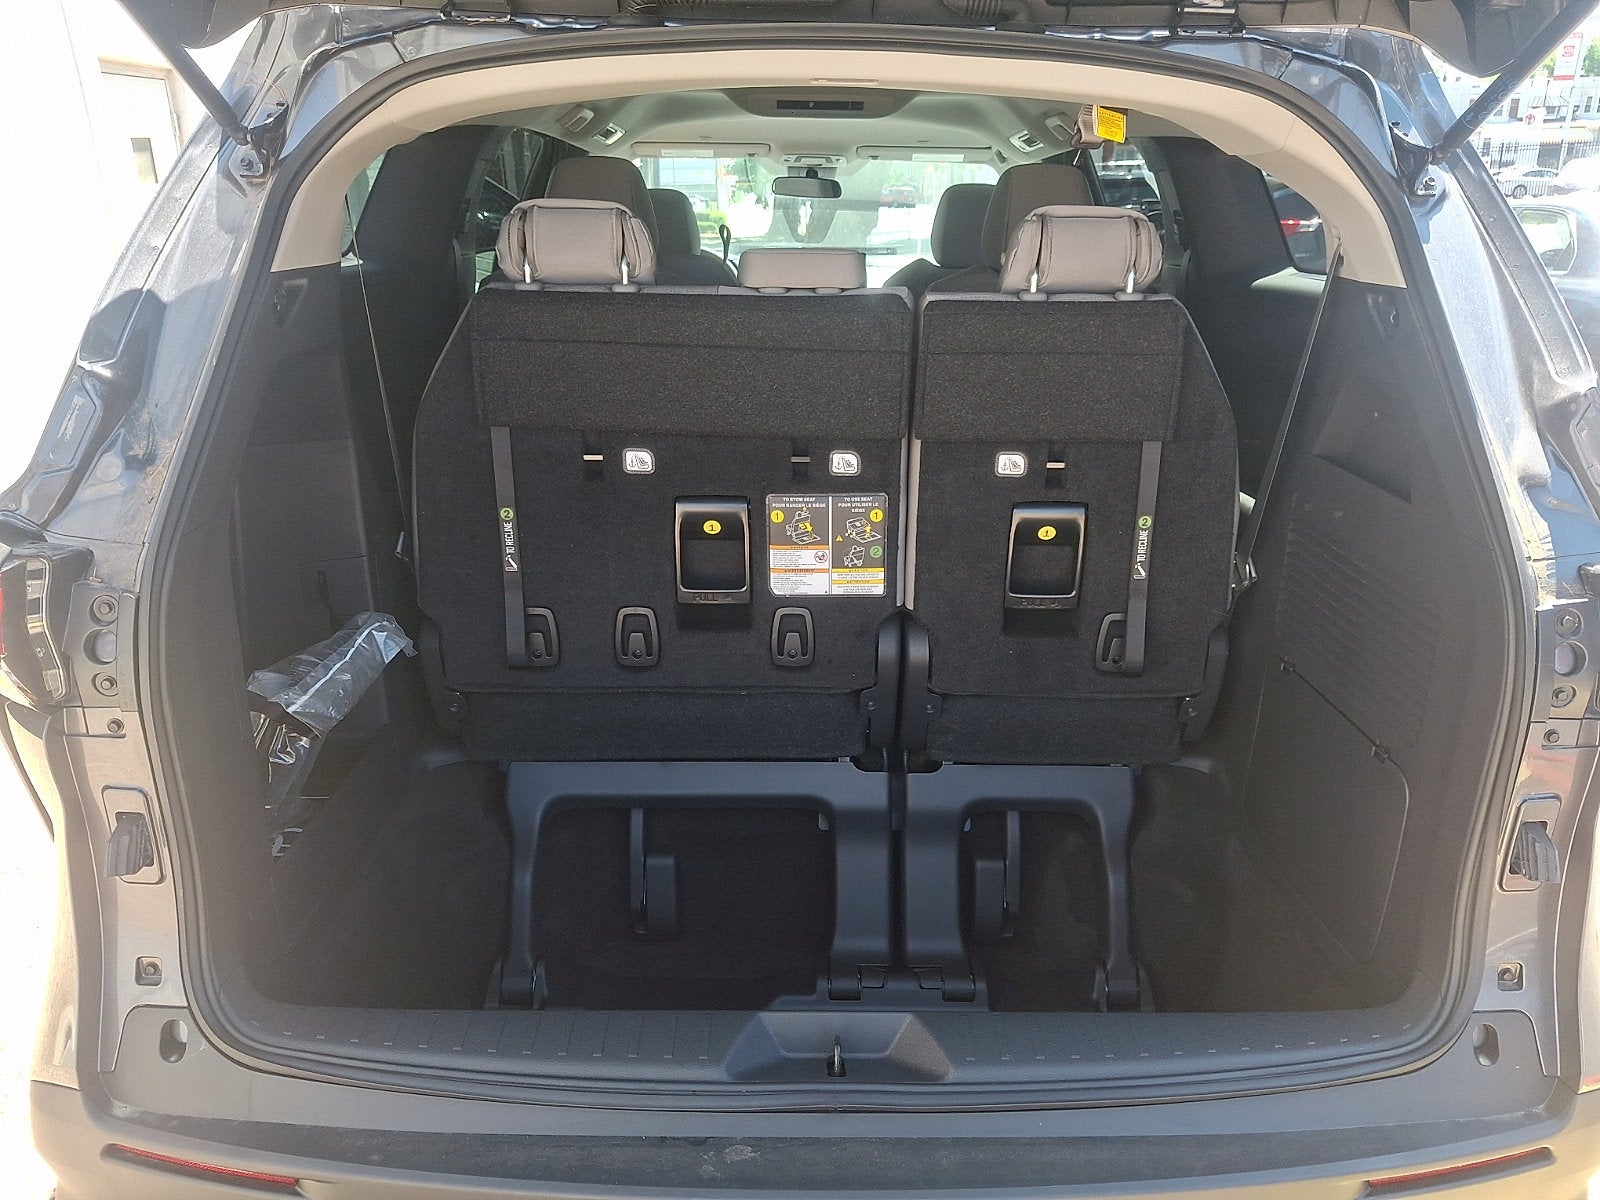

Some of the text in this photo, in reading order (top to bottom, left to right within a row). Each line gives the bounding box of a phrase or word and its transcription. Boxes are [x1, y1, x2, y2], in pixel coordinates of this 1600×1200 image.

[503, 521, 516, 555] TO RECLINE
[1136, 529, 1149, 562] TO RECLINE
